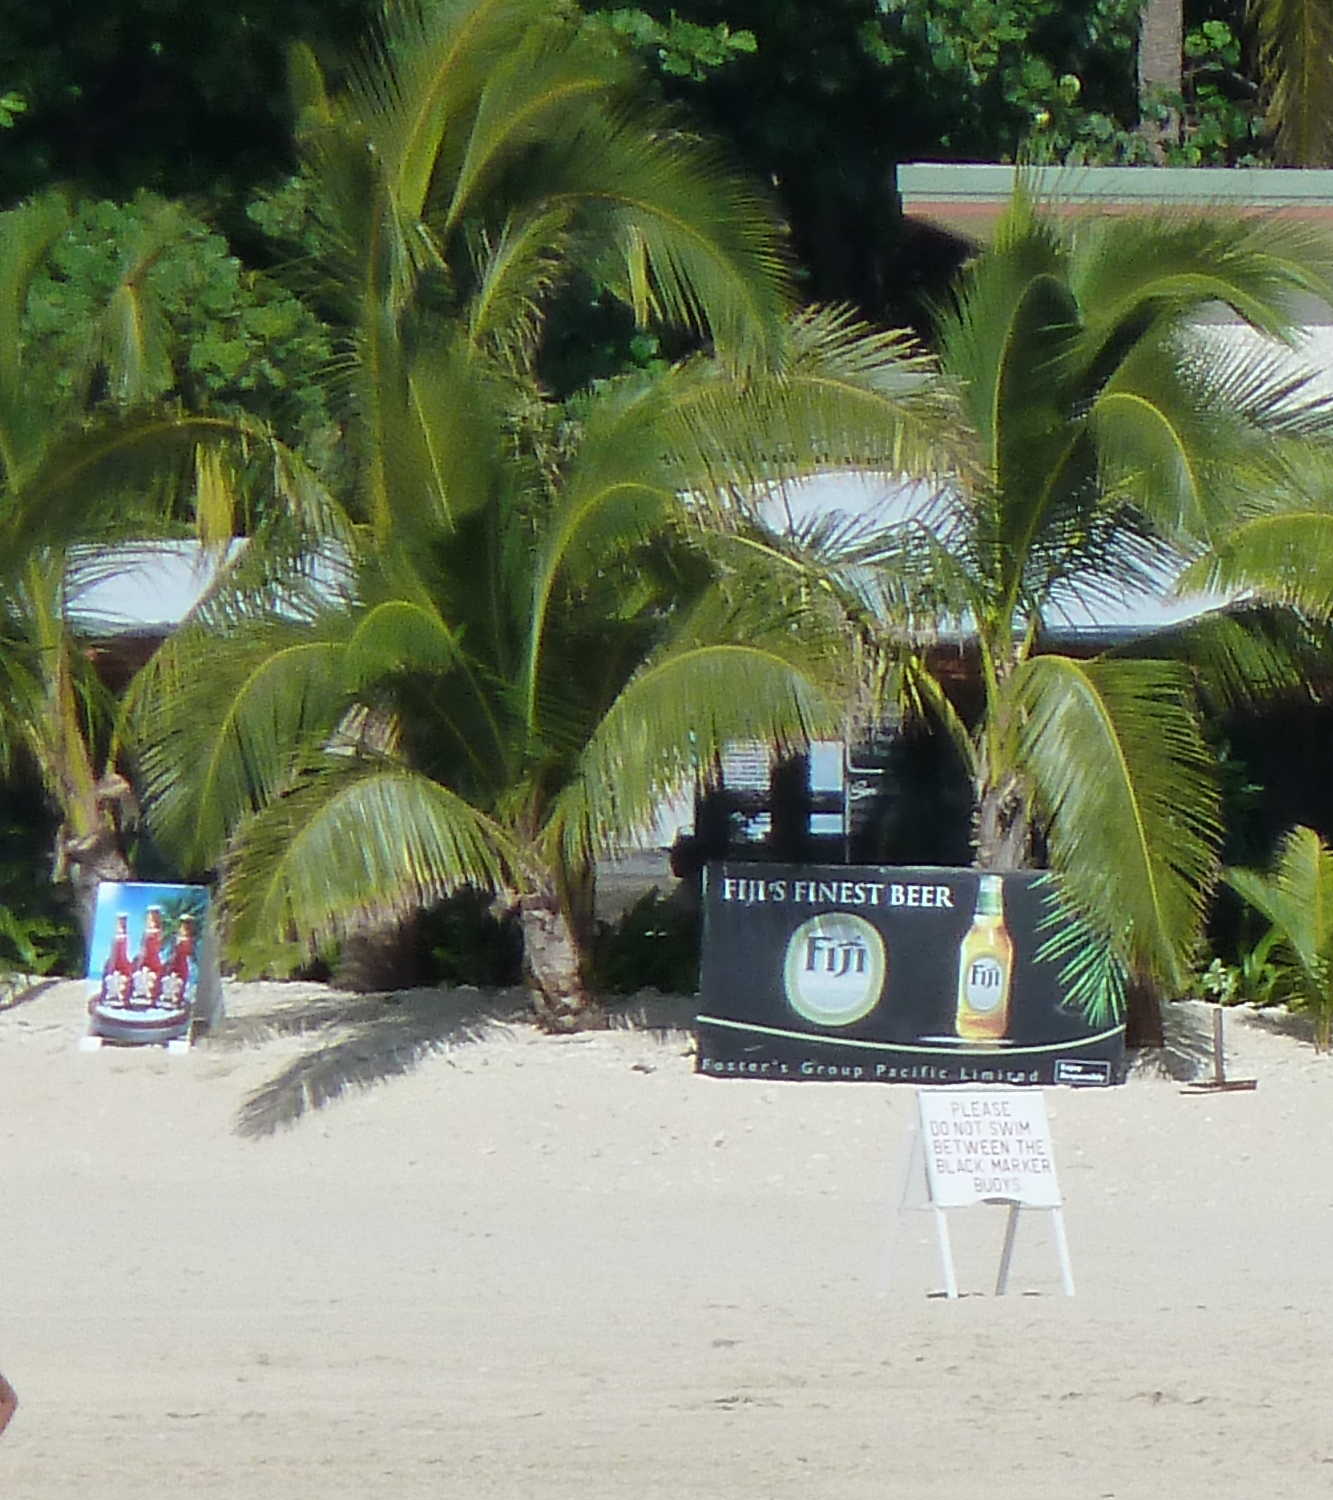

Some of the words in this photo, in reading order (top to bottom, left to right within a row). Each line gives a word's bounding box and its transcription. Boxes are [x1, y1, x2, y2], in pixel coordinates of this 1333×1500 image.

[722, 878, 788, 906] FIJI'S
[795, 881, 885, 906] FINEST
[889, 884, 955, 908] BEER
[702, 1058, 789, 1074] Foster's
[801, 1062, 863, 1078] Group
[876, 1064, 949, 1079] Pacific
[960, 1067, 1039, 1082] Limited
[950, 1101, 1011, 1117] PLEASE
[930, 1120, 949, 1137] DO
[953, 1120, 983, 1137] NOT
[990, 1120, 1031, 1137] SWIM
[933, 1139, 1010, 1156] BETWEEN
[1016, 1139, 1045, 1156] THE
[936, 1158, 983, 1174] BLACK
[991, 1158, 1050, 1174] MARKER
[973, 1177, 1022, 1193] BUOYS
